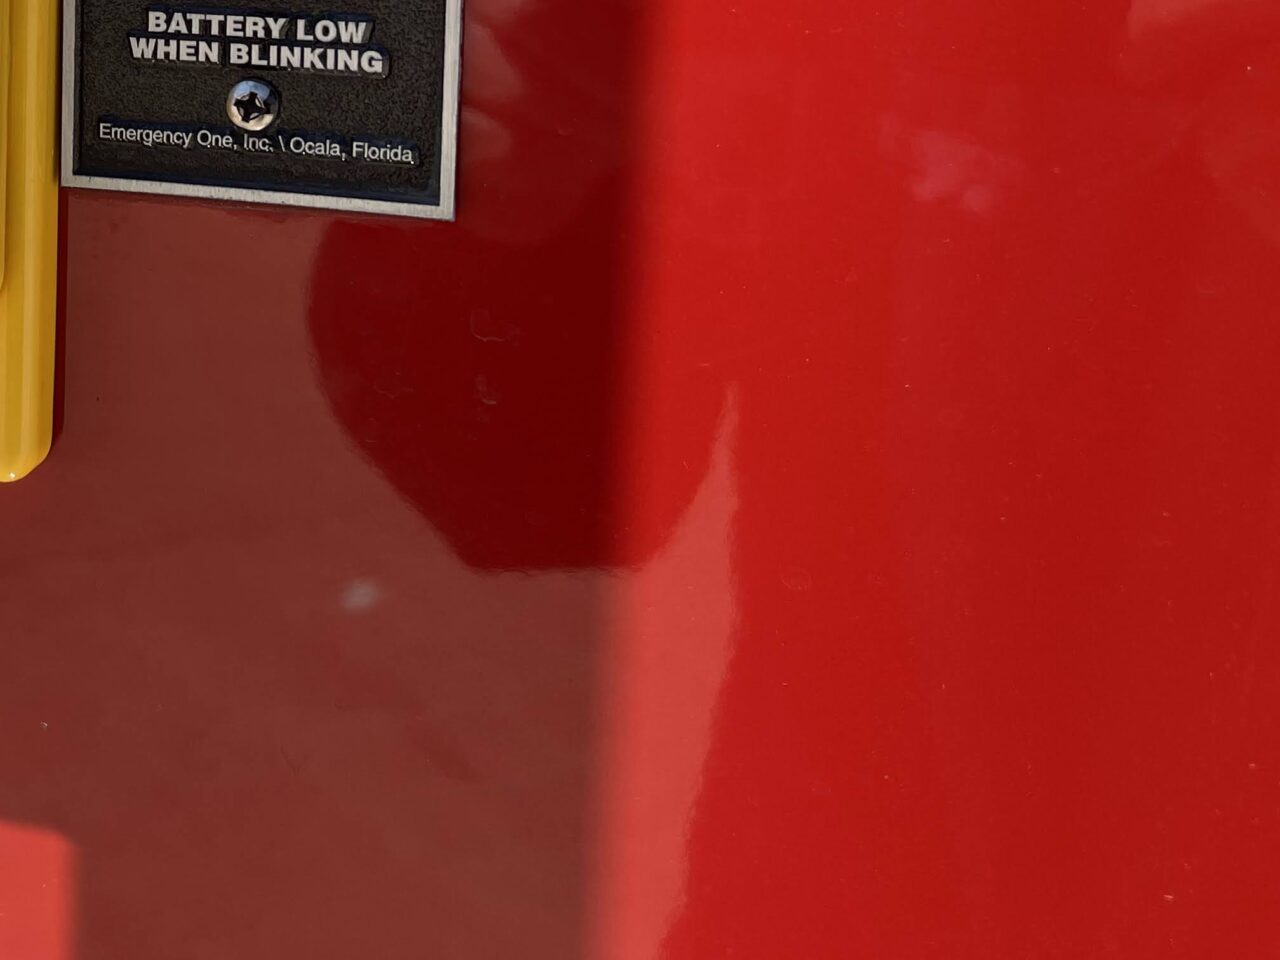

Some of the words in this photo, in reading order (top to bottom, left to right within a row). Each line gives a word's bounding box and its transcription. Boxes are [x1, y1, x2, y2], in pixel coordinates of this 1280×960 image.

[148, 11, 288, 40] BATTERY
[296, 18, 368, 44] LOW
[129, 37, 219, 63] WHEN
[229, 43, 385, 74] BLINKING
[99, 123, 192, 148] Emergency
[197, 130, 237, 151] One,
[244, 133, 273, 152] Inc.
[289, 137, 346, 160] Ocala,
[352, 141, 414, 164] Florida
